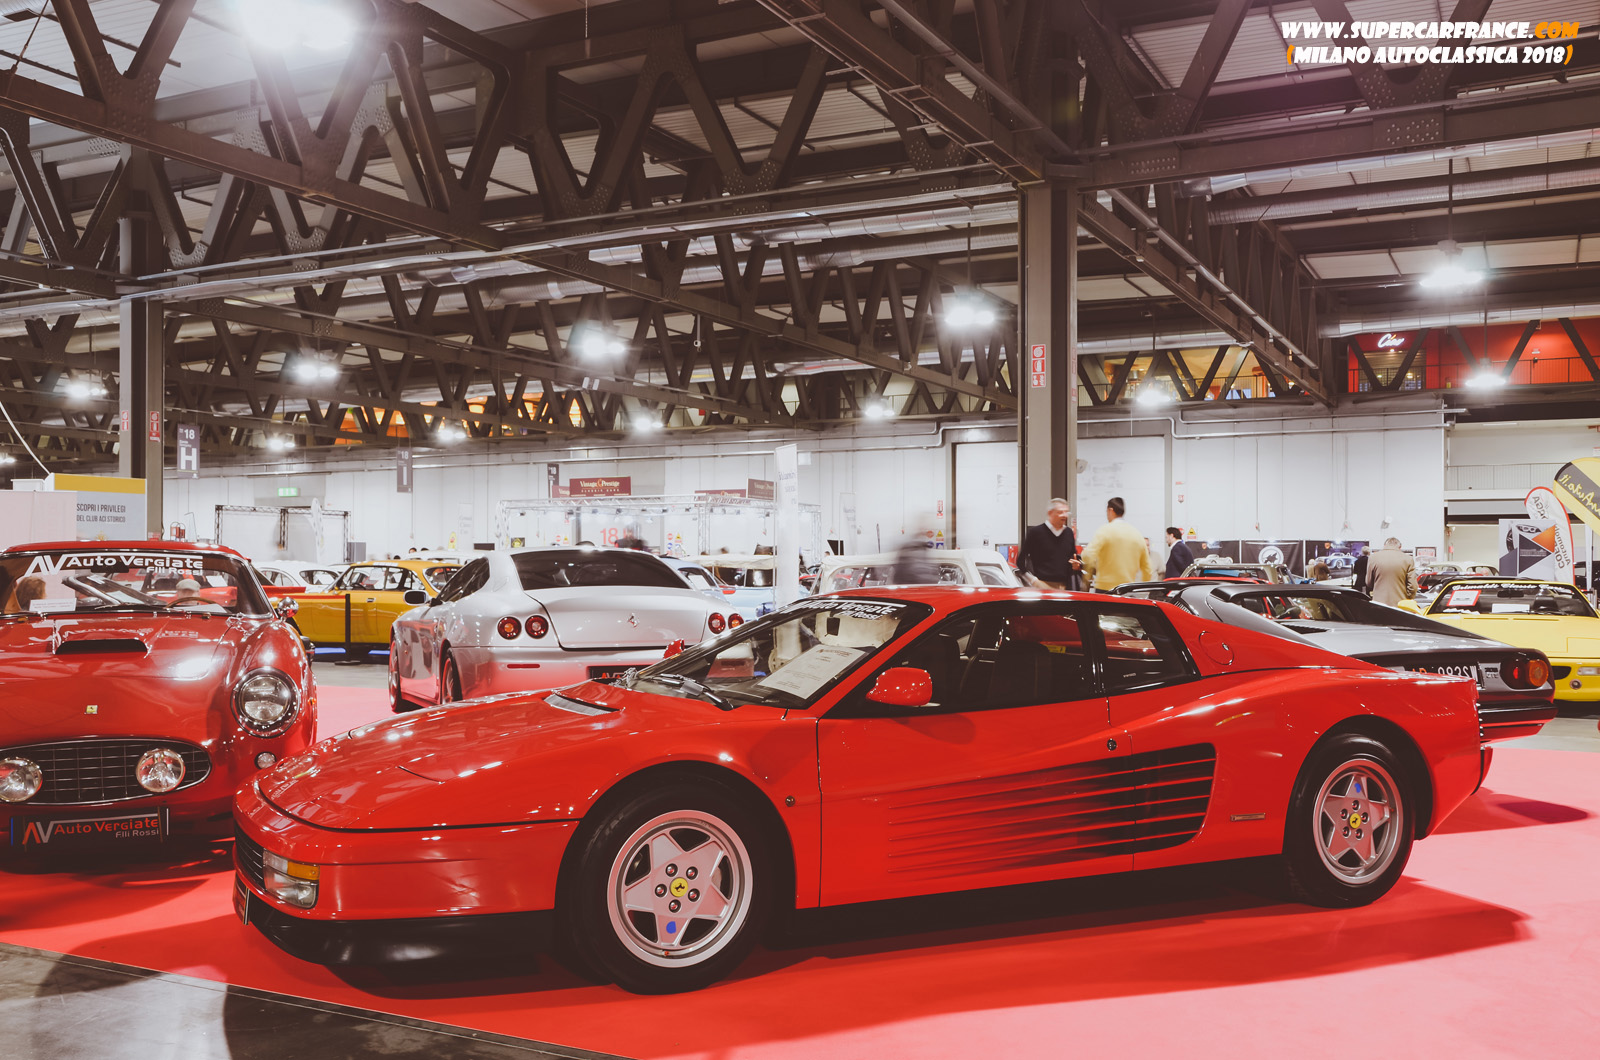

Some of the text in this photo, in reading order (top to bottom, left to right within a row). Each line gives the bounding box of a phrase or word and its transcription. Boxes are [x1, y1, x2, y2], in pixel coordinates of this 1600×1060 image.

[184, 428, 195, 440] 18
[180, 447, 197, 471] H
[76, 503, 96, 512] SCOPRI
[100, 504, 126, 513] PRIVILEGI
[66, 556, 117, 568] Auto
[119, 555, 204, 569] Vergiate
[54, 824, 92, 836] Auto
[94, 818, 158, 832] Vergiate
[132, 828, 159, 837] Rossi
